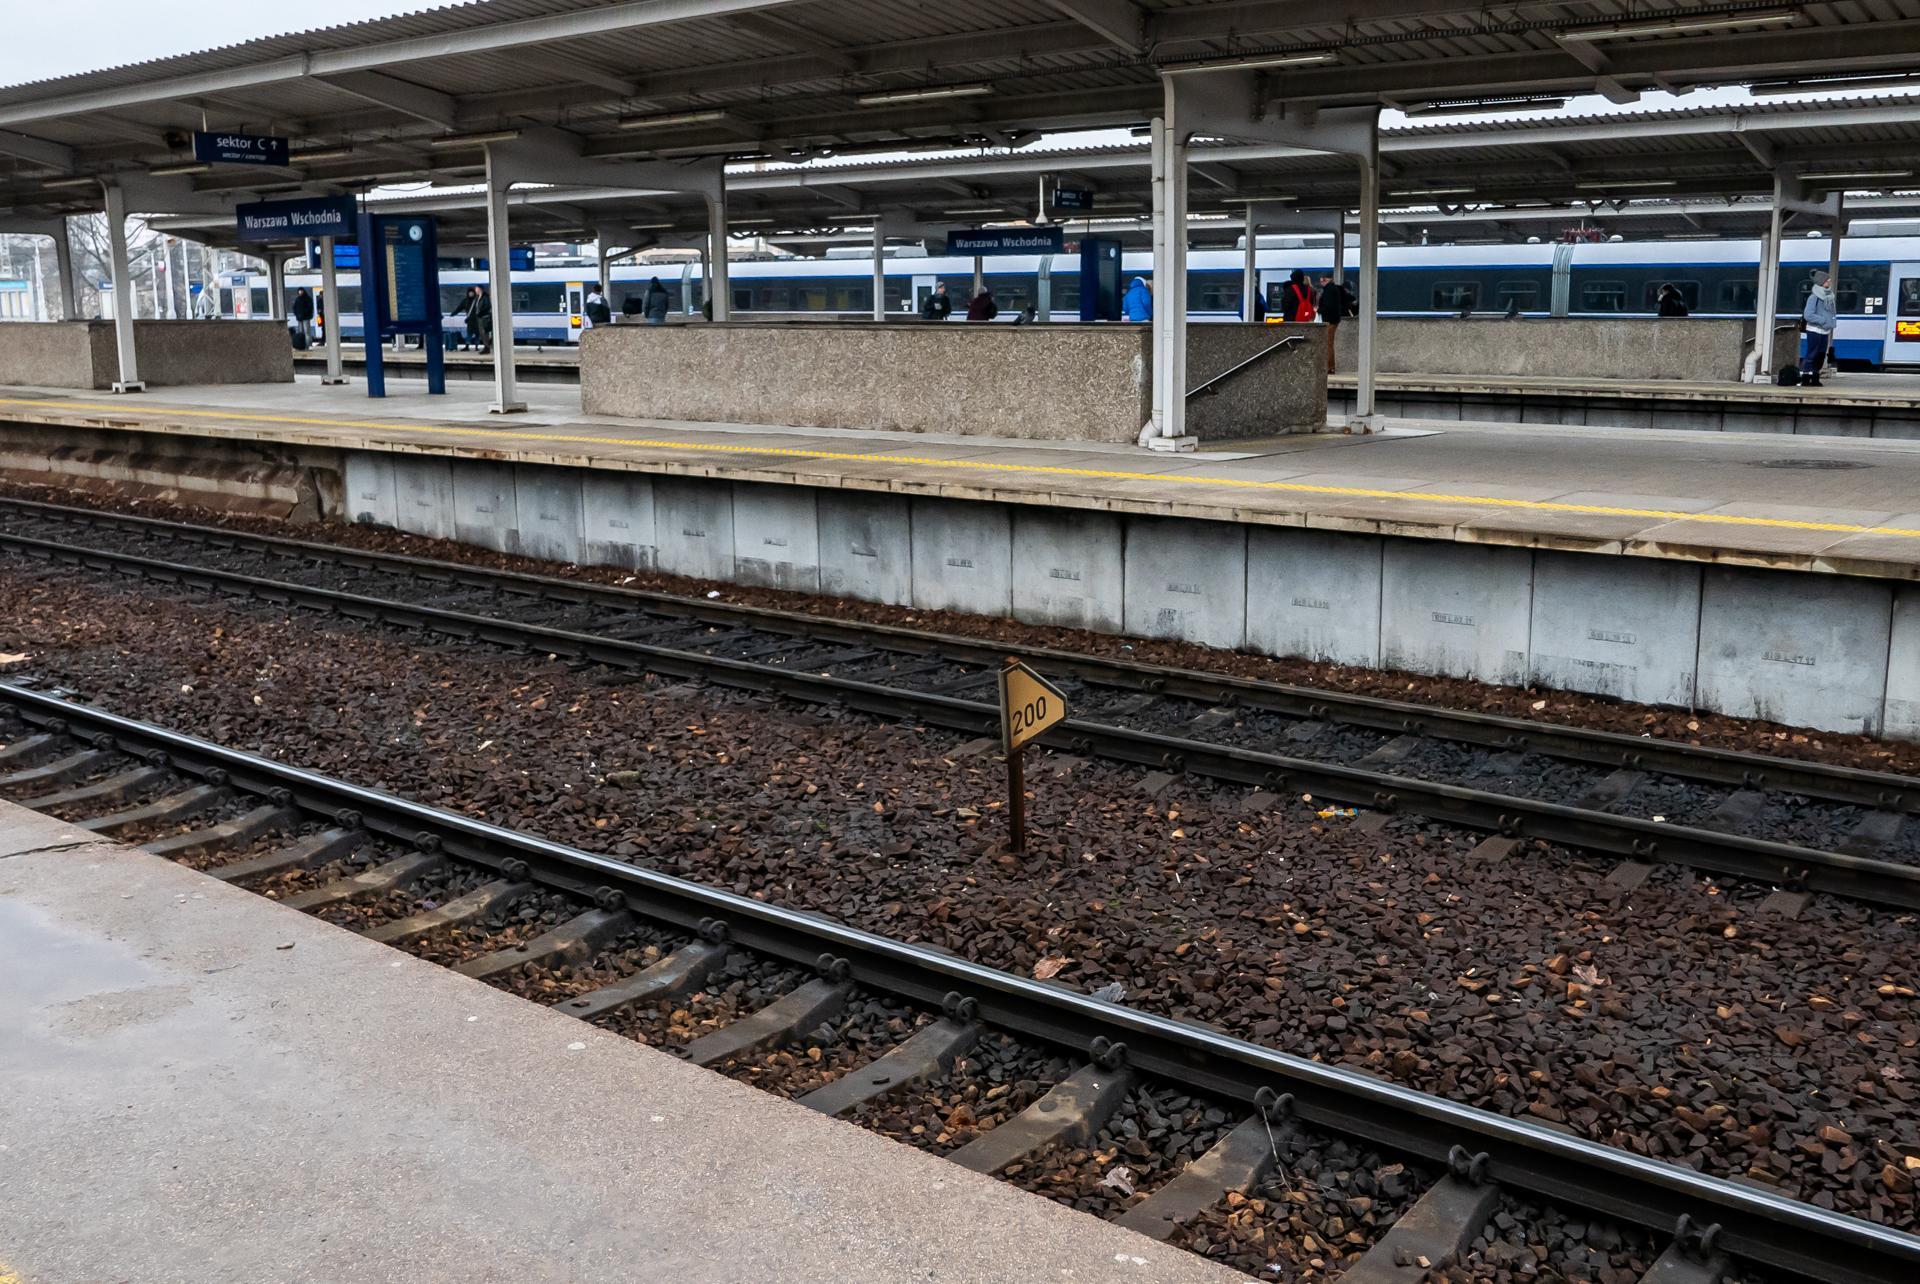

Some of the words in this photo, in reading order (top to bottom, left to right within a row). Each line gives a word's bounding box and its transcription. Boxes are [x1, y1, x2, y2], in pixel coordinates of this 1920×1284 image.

[216, 135, 252, 149] sektor
[257, 138, 267, 150] C
[244, 215, 288, 229] Warszawa
[290, 209, 342, 226] Wschodnia
[955, 239, 999, 249] Warszawa
[1002, 236, 1052, 248] Wschodnia
[1012, 695, 1047, 737] 200
